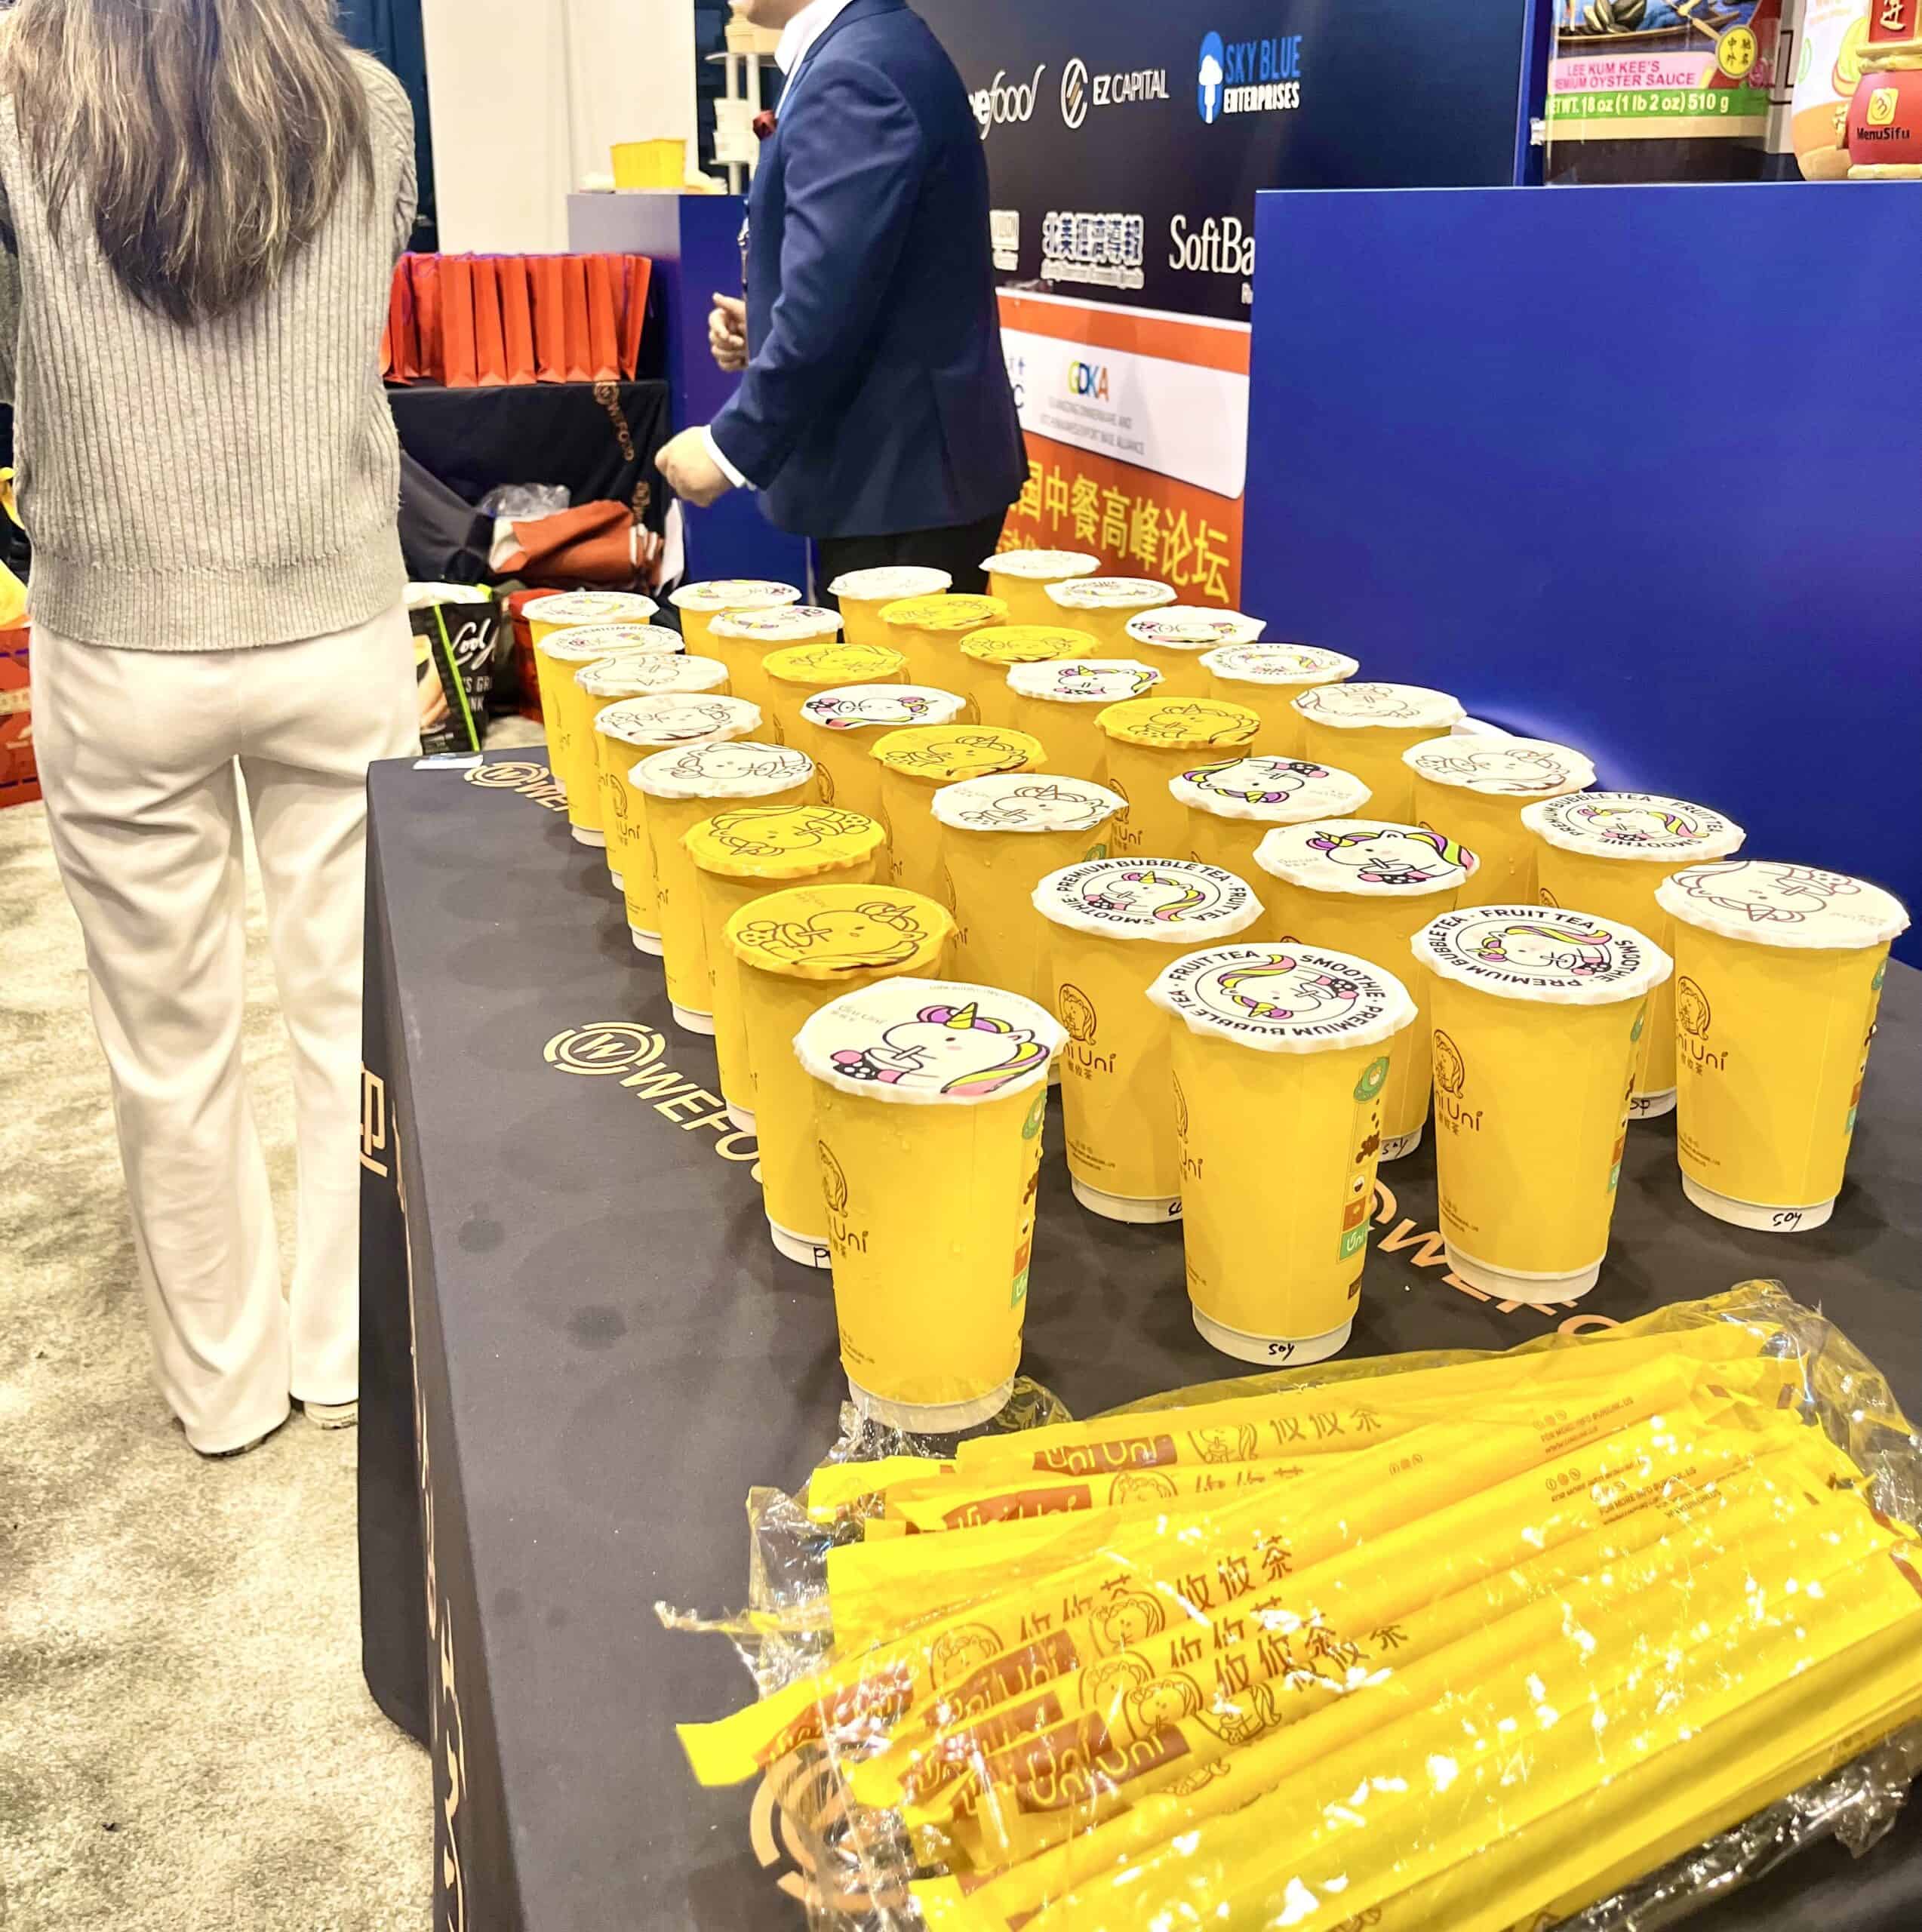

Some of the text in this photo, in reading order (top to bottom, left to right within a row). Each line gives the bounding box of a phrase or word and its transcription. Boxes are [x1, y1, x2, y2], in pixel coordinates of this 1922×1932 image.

[1225, 35, 1302, 81] SKY BLUE
[1567, 60, 1660, 76] LEE KUM KEE'S
[1112, 69, 1169, 104] CAPITAL
[1555, 72, 1695, 90] EMIUM OYSTER SAUCE
[1223, 83, 1300, 114] ENTERPRISES
[1582, 96, 1595, 112] 18
[1597, 99, 1613, 112] oz
[1632, 94, 1647, 111] lb
[1649, 94, 1658, 111] 2
[1662, 92, 1685, 112] oz)
[1688, 93, 1716, 111] 510
[1720, 96, 1729, 112] g
[1857, 128, 1910, 140] MenuSifu
[1169, 214, 1255, 276] SoftBa
[1551, 792, 1610, 808] BUBBLE
[1617, 792, 1652, 802] TEA
[1671, 801, 1708, 820] FRUIT
[1598, 837, 1702, 848] SMOOTHIE
[1056, 863, 1114, 892] PREMIUM
[1116, 860, 1198, 871] BUBBLE
[1200, 866, 1232, 882] TEA
[1062, 897, 1156, 925] SMOOTHIE
[1190, 910, 1230, 921] TEA
[1428, 909, 1642, 987] PREMIUM BUBBLE TEA FRUIT TEA SMOOTHIE
[1168, 949, 1386, 1037] PREMIUM BUBBLE TEA FRUIT TEA SMOOTHIE
[1078, 1046, 1117, 1073] Uni
[1691, 1039, 1729, 1071] Uni
[1447, 1097, 1483, 1131] Uni
[833, 1216, 869, 1254] Uni
